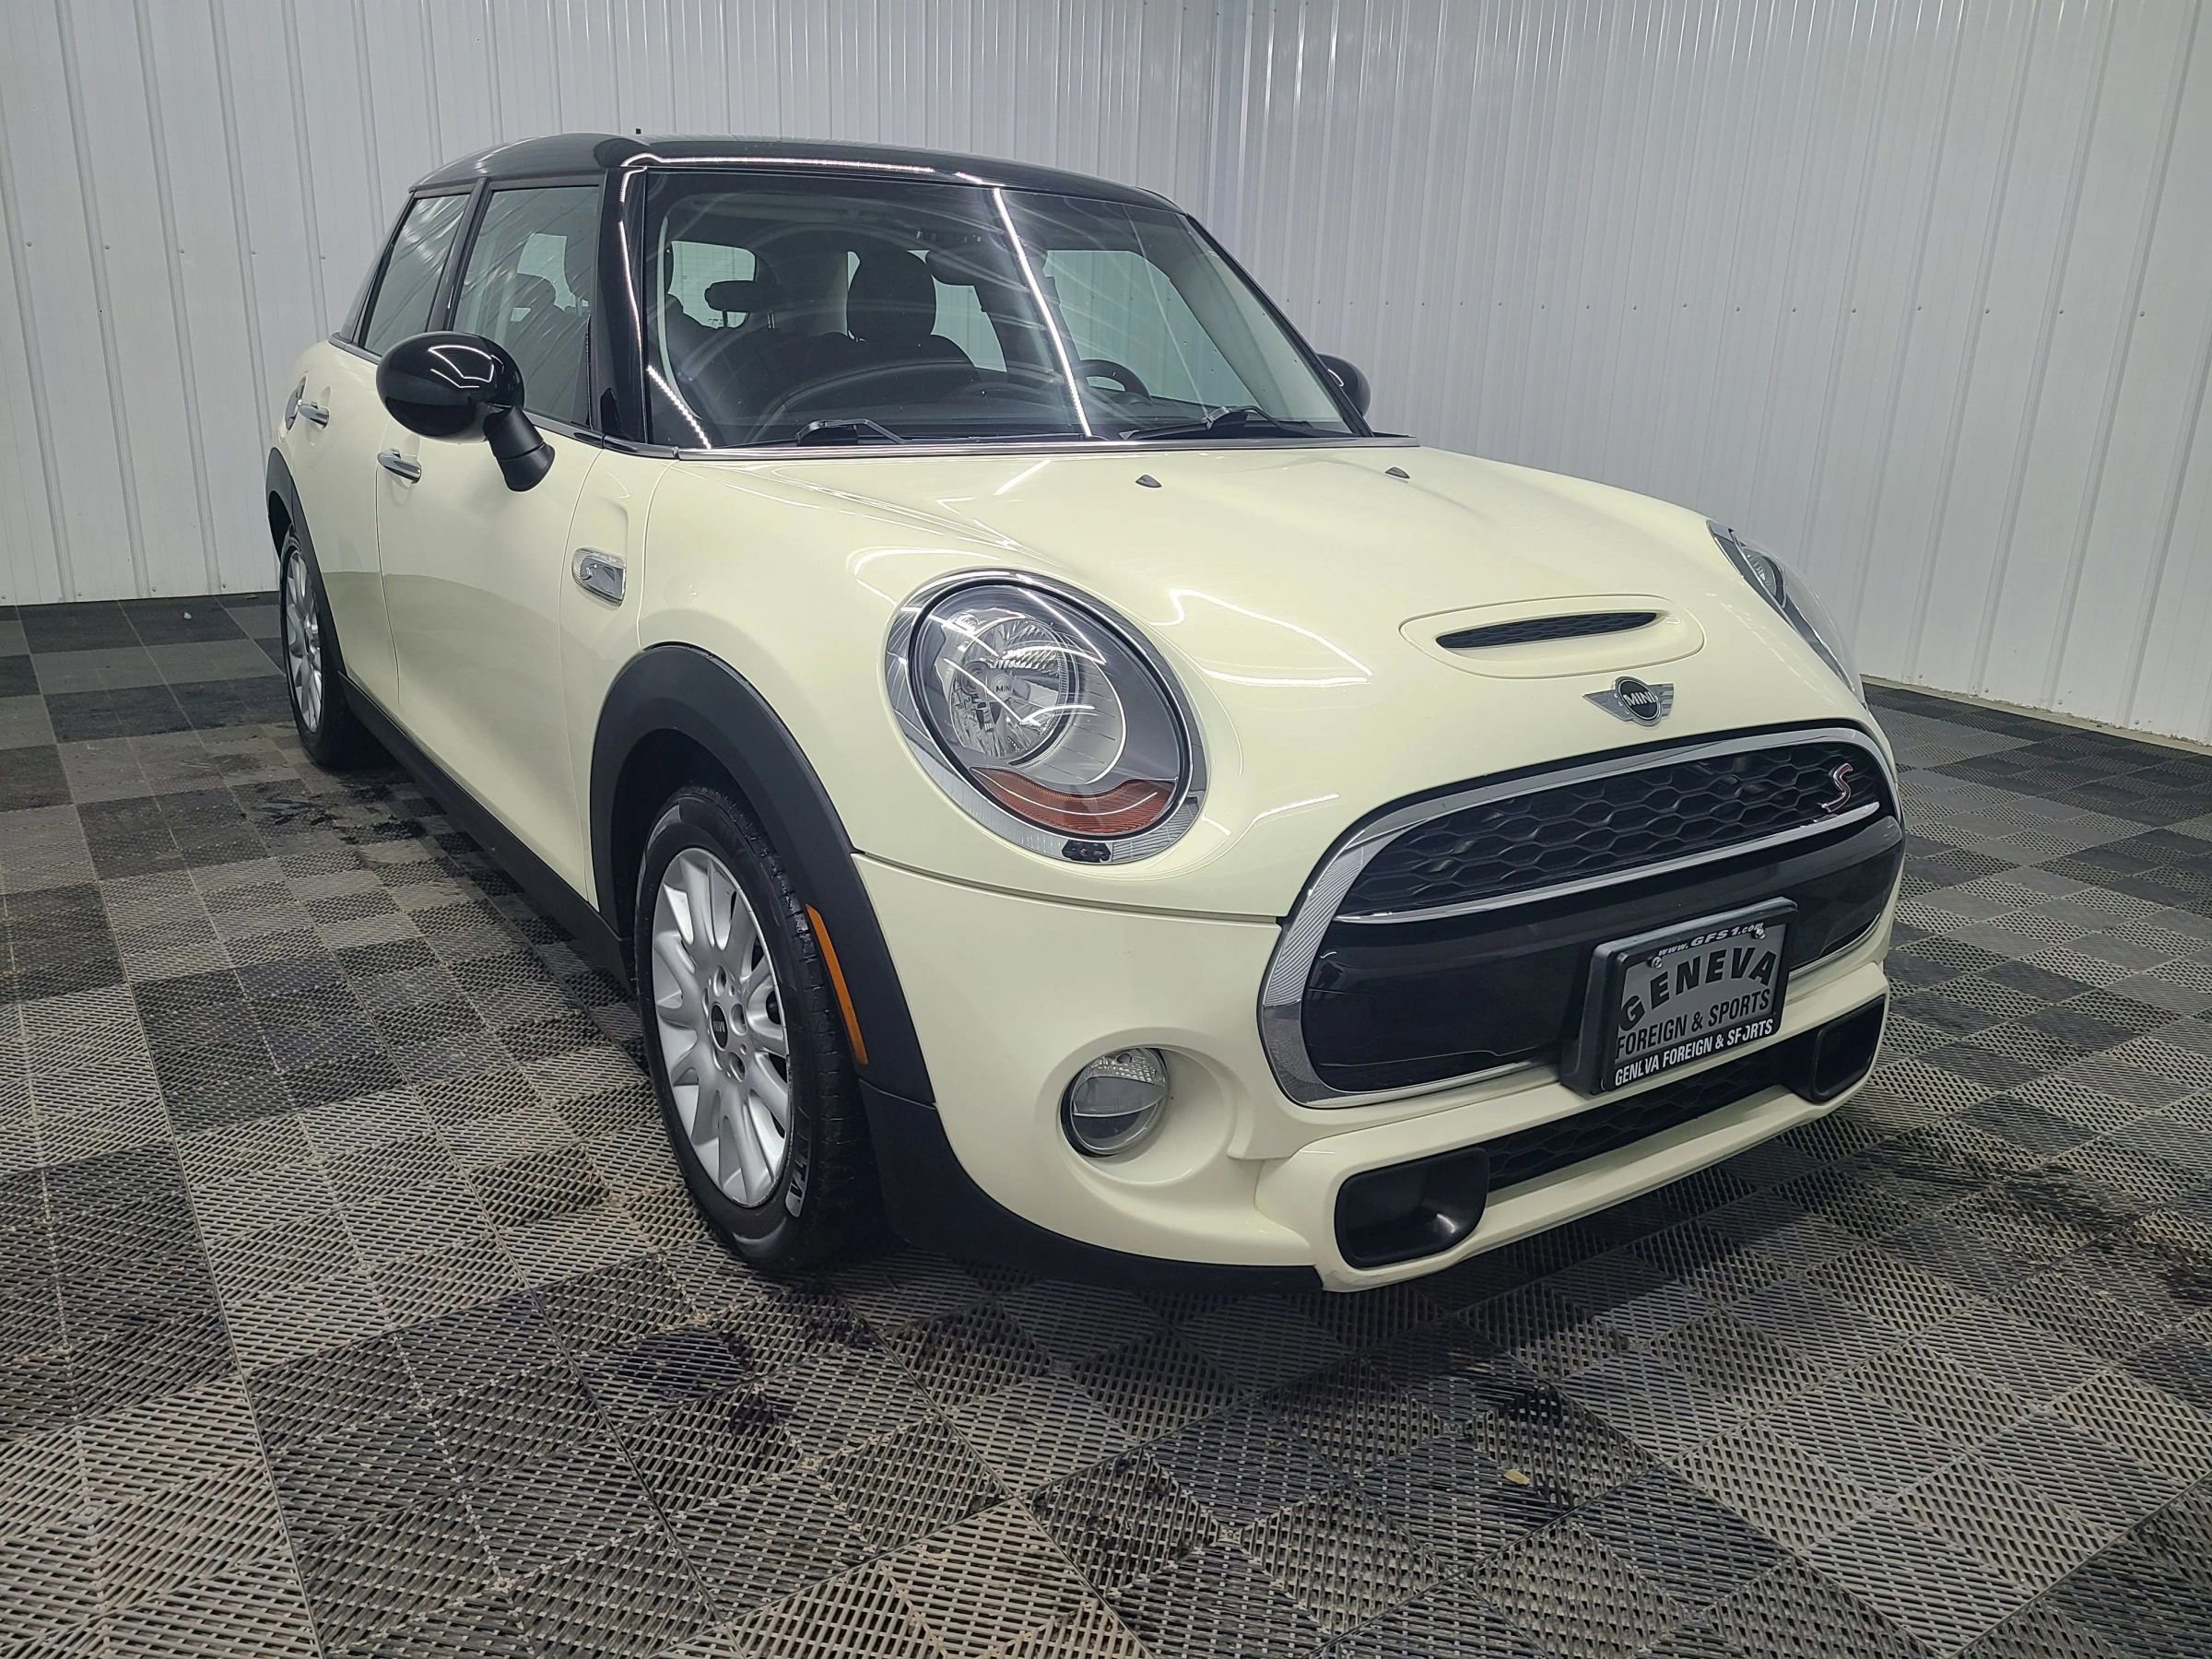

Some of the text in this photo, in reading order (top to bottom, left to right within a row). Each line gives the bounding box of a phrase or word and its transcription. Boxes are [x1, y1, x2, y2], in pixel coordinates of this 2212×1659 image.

[1622, 690, 1657, 707] MINI
[1618, 947, 1777, 1031] GENEVA
[1615, 988, 1771, 1060] FOREIGN & SPORTS
[1662, 1036, 1713, 1068] FOREIGN
[1715, 1033, 1724, 1050] &
